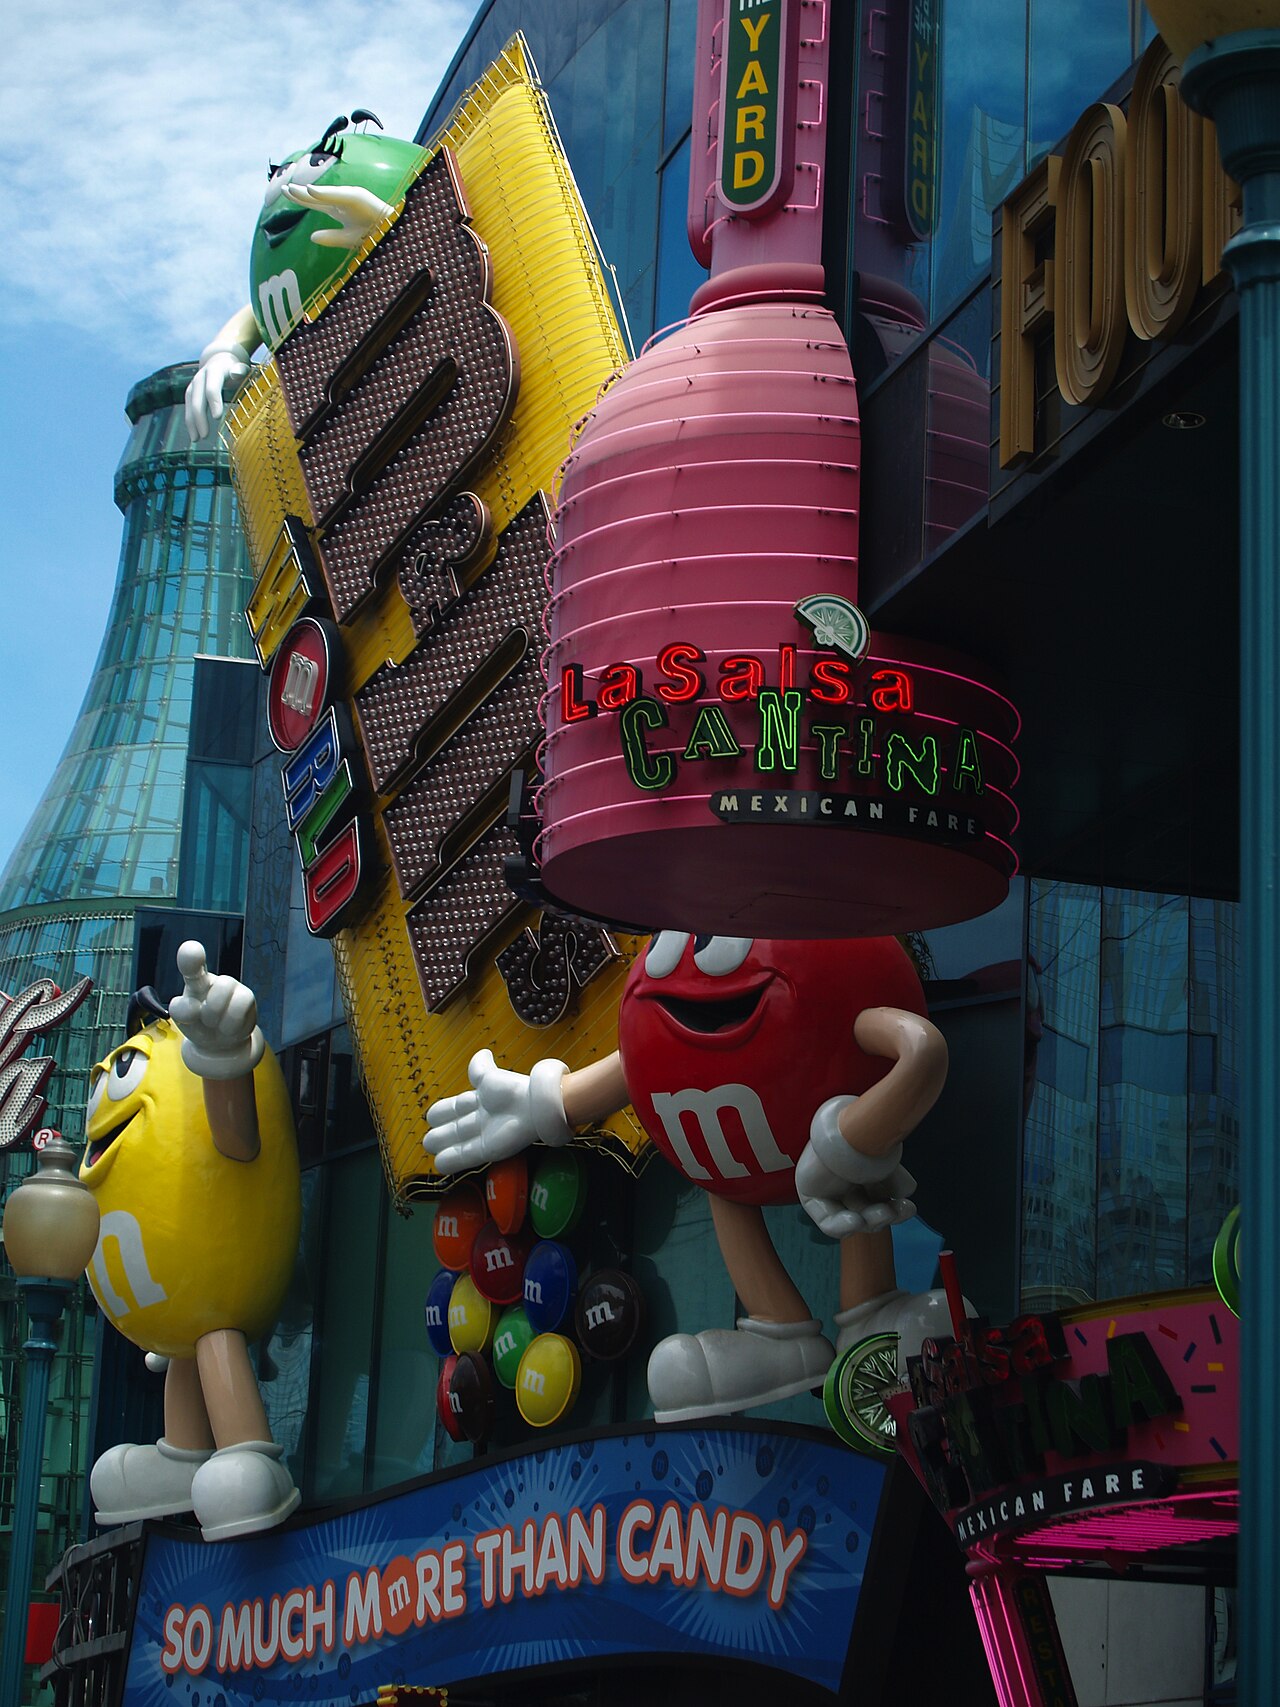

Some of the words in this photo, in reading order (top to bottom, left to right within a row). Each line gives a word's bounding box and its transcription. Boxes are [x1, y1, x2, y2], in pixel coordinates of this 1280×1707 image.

[733, 13, 771, 189] YARD
[1001, 34, 1242, 470] FOO
[719, 794, 884, 820] MEXICAN
[909, 807, 976, 835] FARE
[651, 1083, 796, 1181] m
[437, 1215, 459, 1238] m
[484, 1245, 514, 1272] m
[524, 1278, 543, 1304] m
[585, 1301, 615, 1331] m
[494, 1330, 517, 1361] m
[523, 1368, 545, 1397] m
[957, 1489, 1045, 1542] MEXICAN
[1063, 1467, 1145, 1503] FARE
[161, 1604, 213, 1674] SO
[217, 1582, 334, 1672] MUCH
[477, 1505, 604, 1606] THAN
[618, 1500, 806, 1609] CANDY
